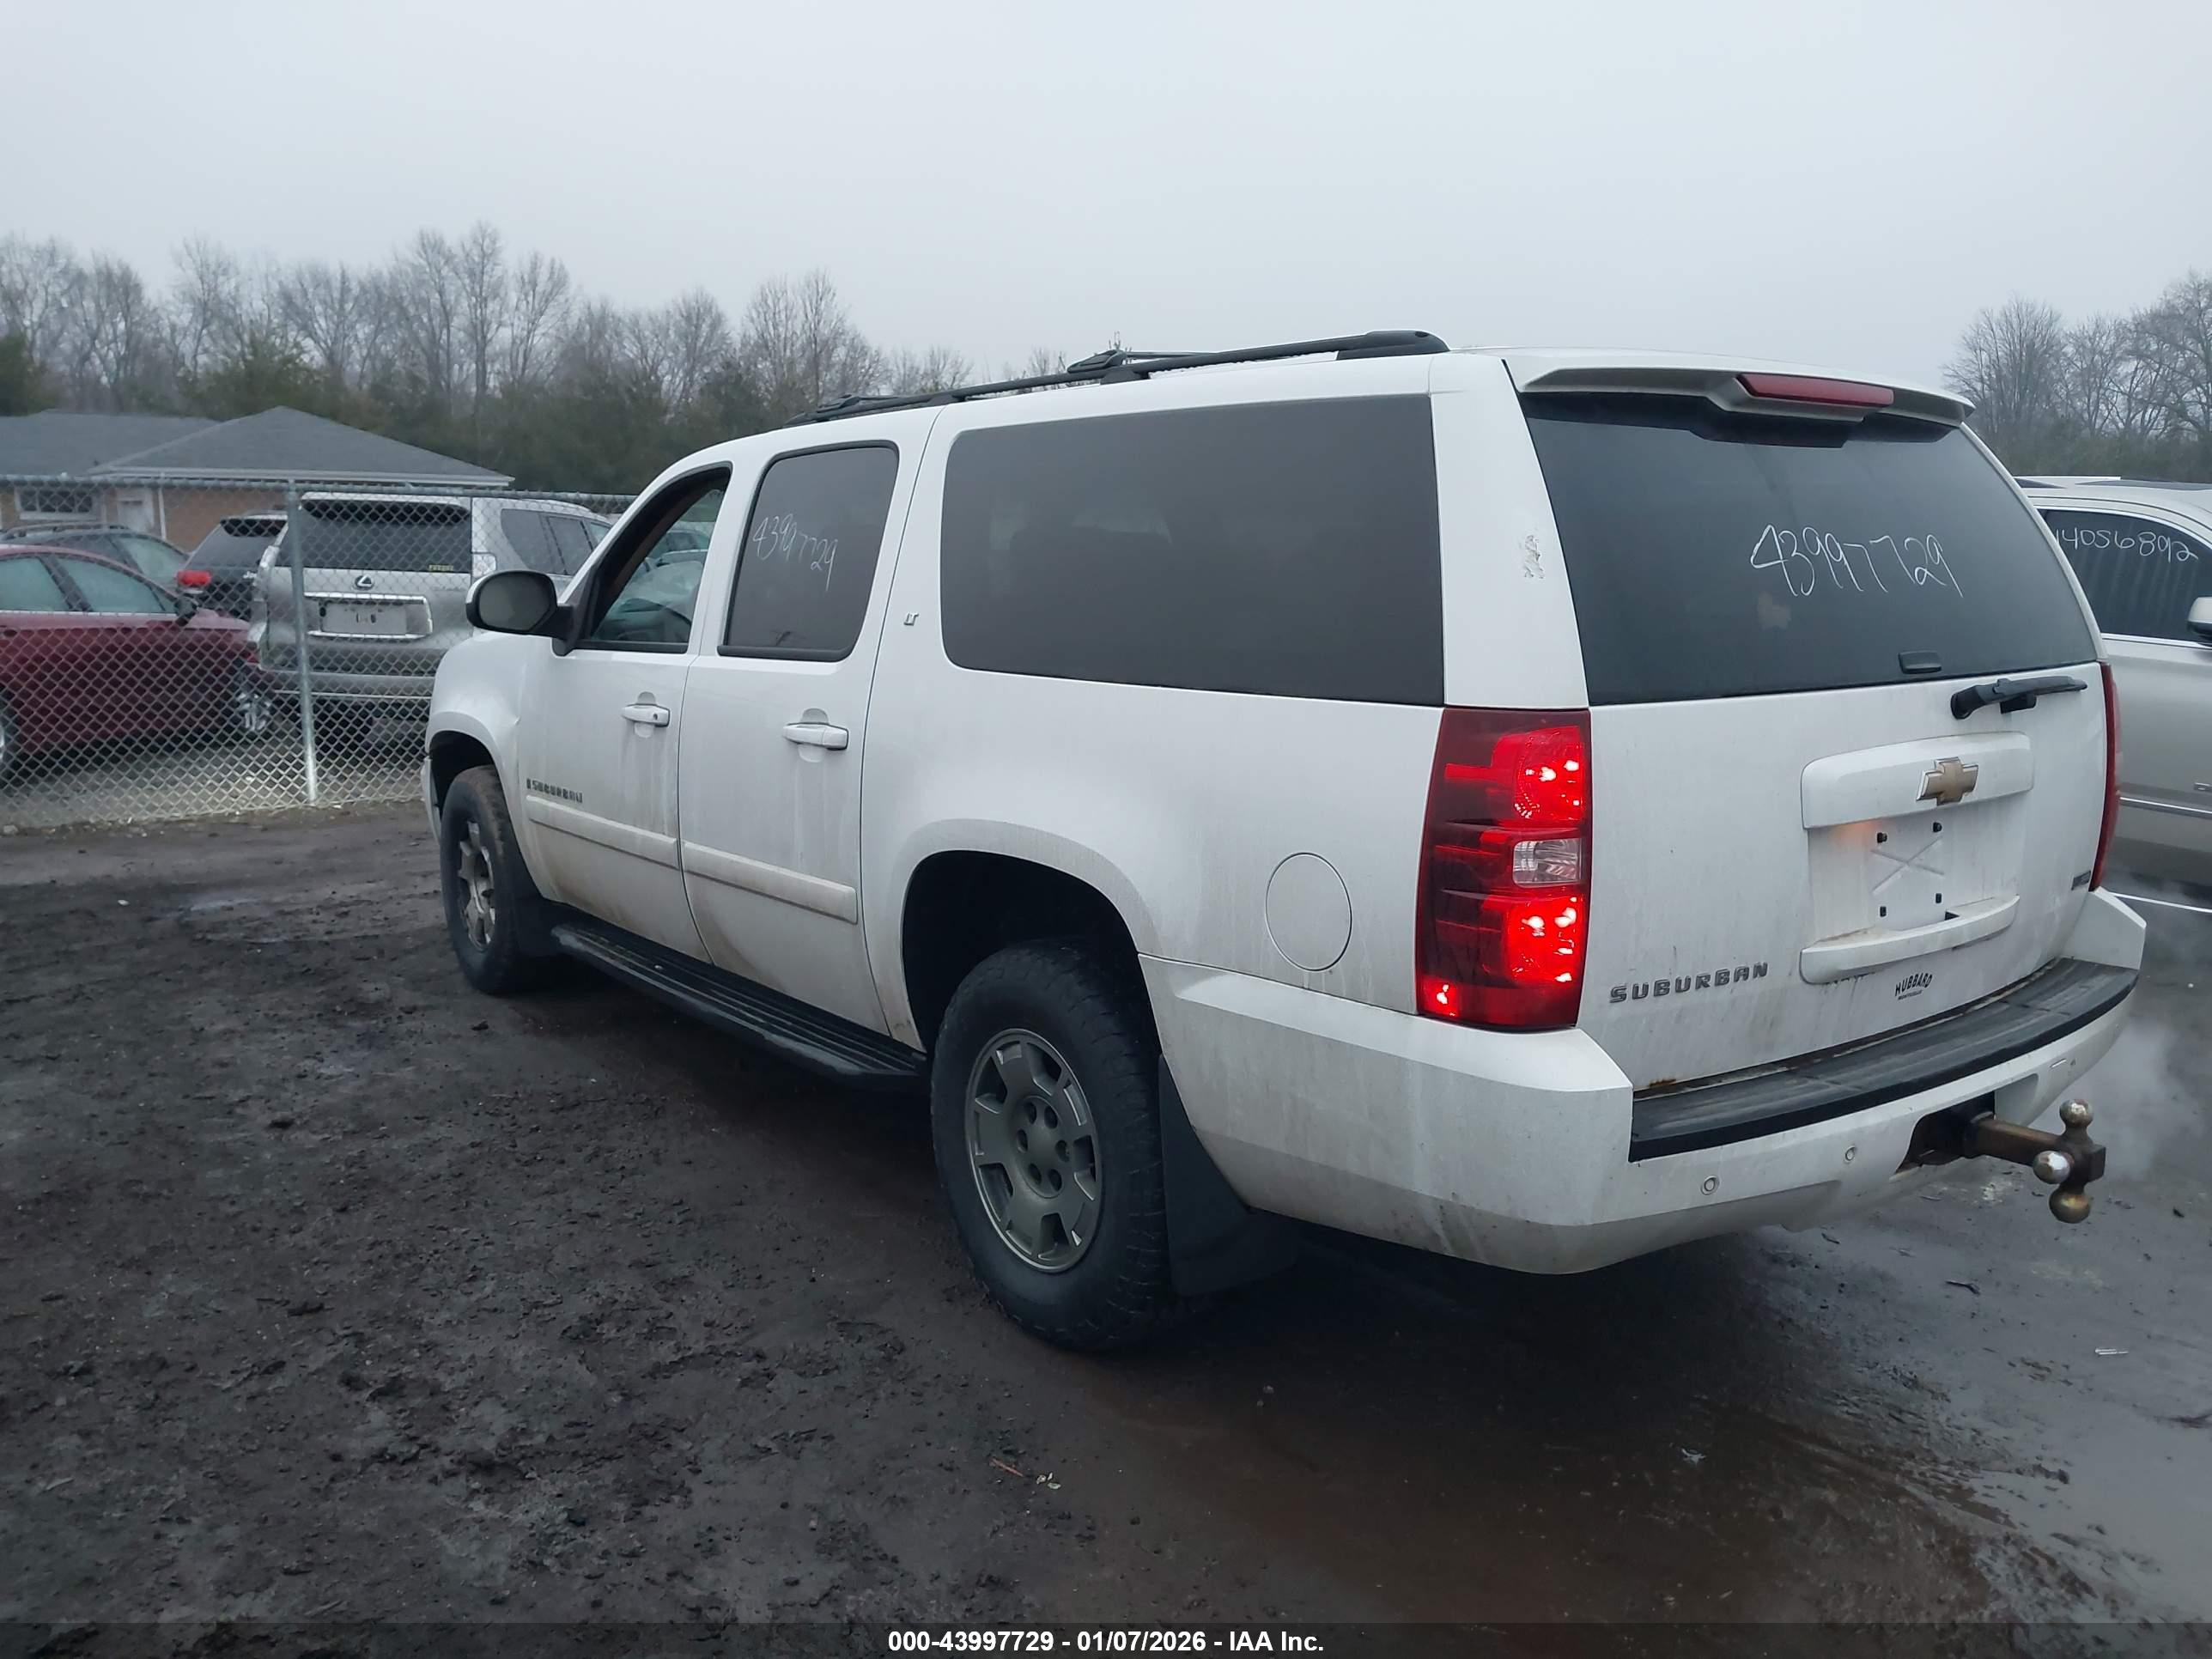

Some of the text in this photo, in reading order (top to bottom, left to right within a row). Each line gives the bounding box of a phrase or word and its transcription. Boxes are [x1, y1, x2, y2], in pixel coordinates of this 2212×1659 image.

[1750, 524, 1964, 598] 43997729
[2055, 527, 2199, 563] 4056892
[1609, 963, 1768, 1004] SUBURBAN
[1895, 973, 1933, 997] HUBBARD
